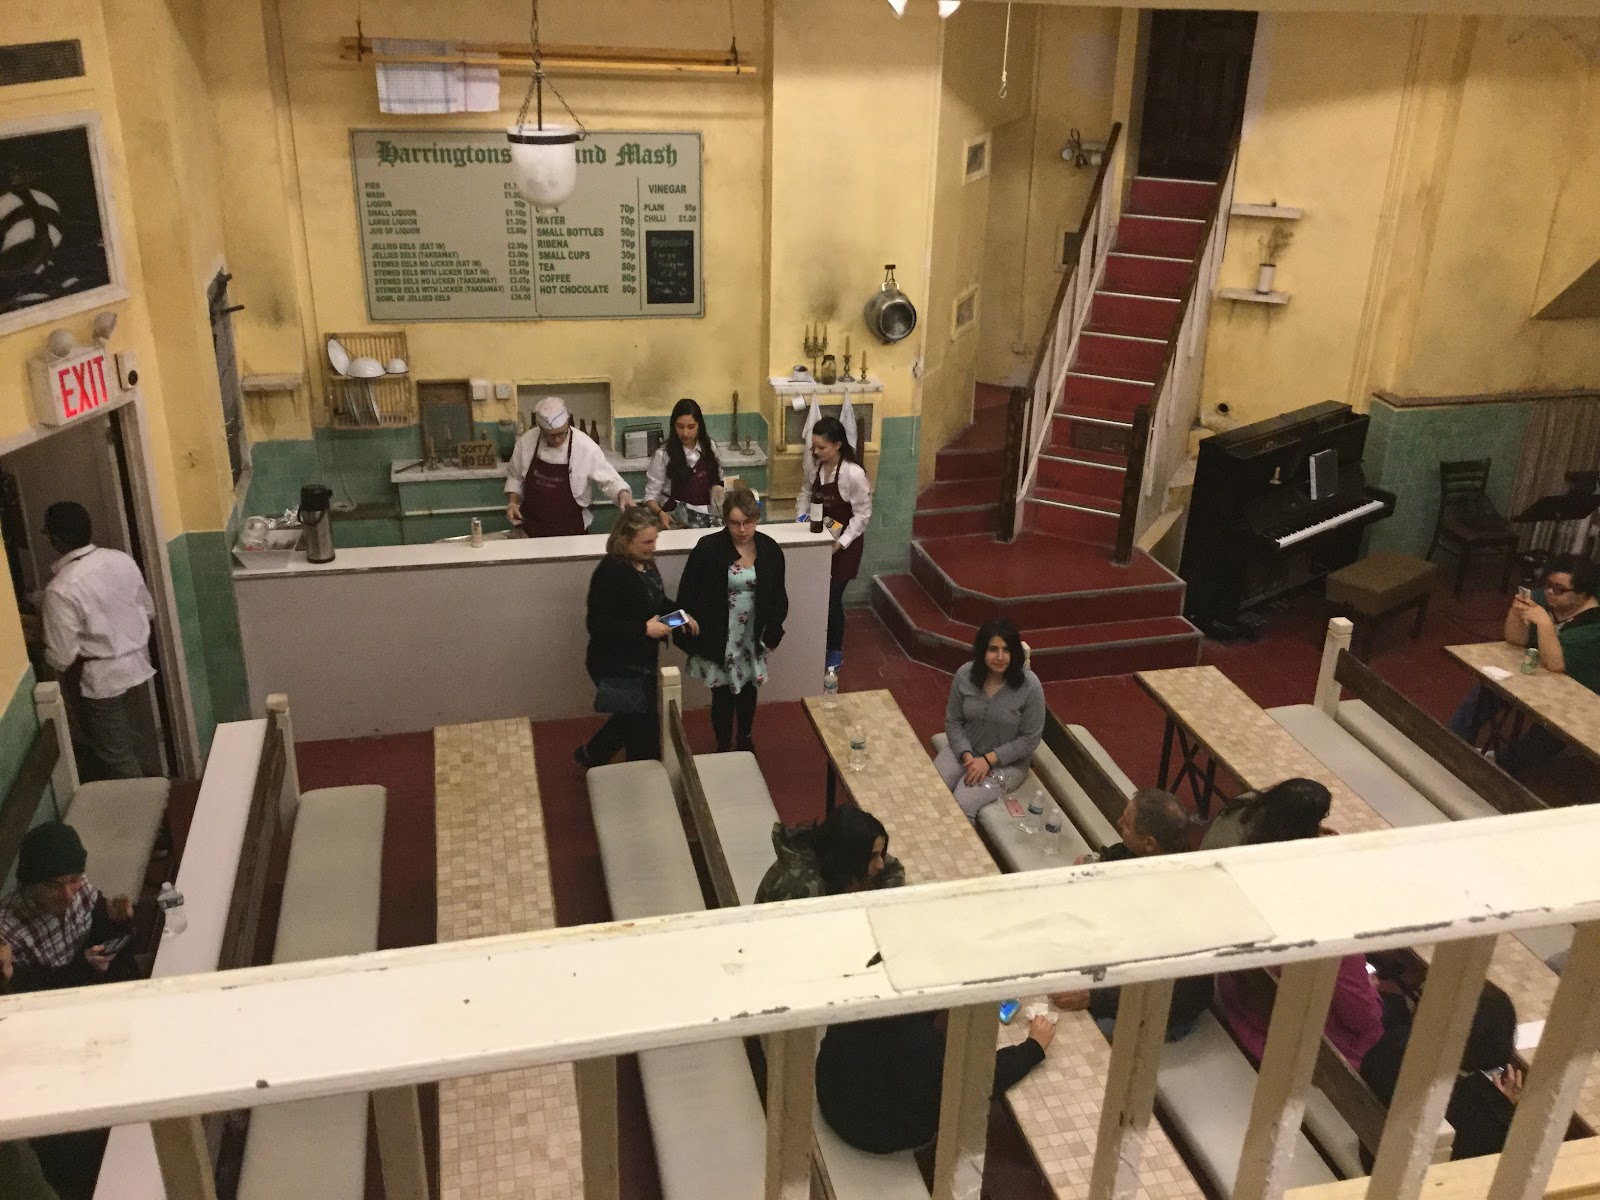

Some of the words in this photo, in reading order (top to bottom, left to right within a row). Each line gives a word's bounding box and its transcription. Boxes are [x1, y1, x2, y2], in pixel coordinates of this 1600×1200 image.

[376, 140, 512, 167] Harringtons
[615, 142, 678, 167] Mash
[648, 184, 687, 194] VINEGAR
[620, 204, 635, 214] 70p
[644, 204, 664, 212] PLAIN
[536, 216, 566, 225] WATER
[620, 216, 636, 227] 70p
[644, 214, 666, 222] CHILLI
[678, 214, 697, 222] £1.00
[395, 227, 420, 235] LIQUOR
[536, 228, 565, 237] SMALL
[566, 228, 604, 237] BOTTLES
[620, 228, 636, 238] 50p
[537, 240, 569, 248] RIBENA
[620, 239, 636, 250] 70p
[418, 251, 460, 260] (TAKEAWAY)
[538, 251, 566, 260] SMALL
[568, 250, 590, 260] CUPS
[621, 250, 636, 261] 30p
[372, 260, 400, 268] STEWED
[419, 260, 429, 268] NO
[430, 260, 454, 268] LICKER
[538, 262, 555, 272] TEA
[622, 262, 636, 273] 80p
[374, 269, 400, 277] STEWED
[438, 268, 462, 276] LICKER
[374, 278, 402, 286] STEWED
[420, 278, 430, 286] NO
[457, 276, 497, 286] (TAKEAWAY)
[538, 274, 570, 282] COFFEE
[622, 274, 636, 284] 80p
[375, 286, 402, 294] STEWED
[465, 286, 505, 294] (TAKEAWAY)
[540, 286, 557, 294] HOT
[559, 284, 609, 294] CHOCOLATE
[622, 284, 637, 295] 80p
[58, 355, 108, 418] EXIT
